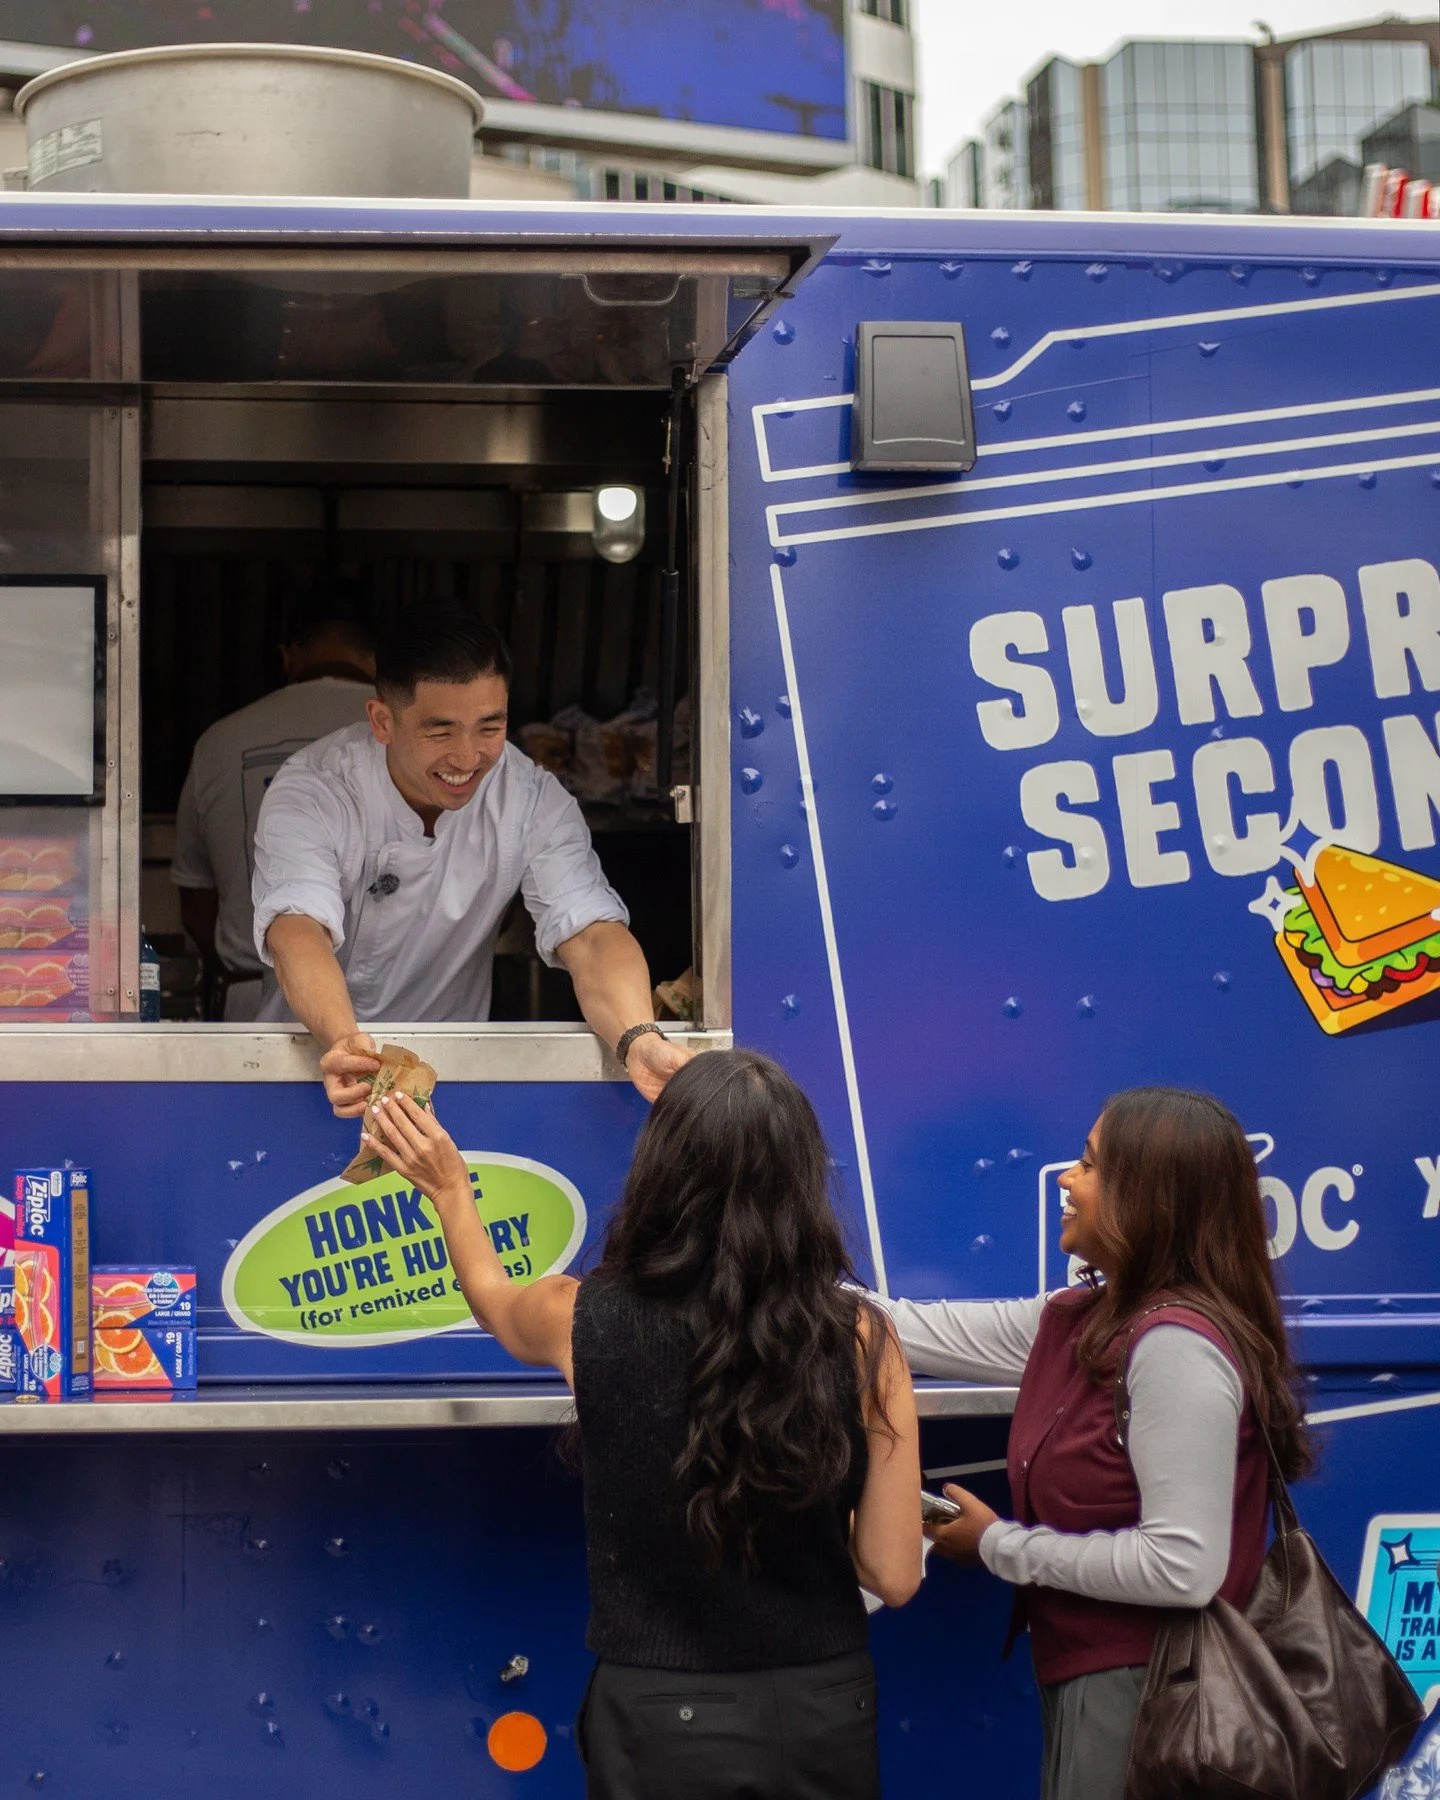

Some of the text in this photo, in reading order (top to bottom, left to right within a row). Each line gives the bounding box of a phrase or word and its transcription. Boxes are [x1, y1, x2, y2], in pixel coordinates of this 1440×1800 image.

[969, 558, 1440, 751] SURPR
[1020, 711, 1440, 901] SECON
[27, 1181, 47, 1235] Ziploc
[304, 1187, 434, 1258] HONK
[279, 1213, 530, 1308] YOU'RE HURY
[180, 1301, 191, 1311] 19
[300, 1307, 343, 1330] (for
[349, 1277, 447, 1316] remixed
[166, 1332, 175, 1344] 19
[1396, 1639, 1437, 1661] IS A
